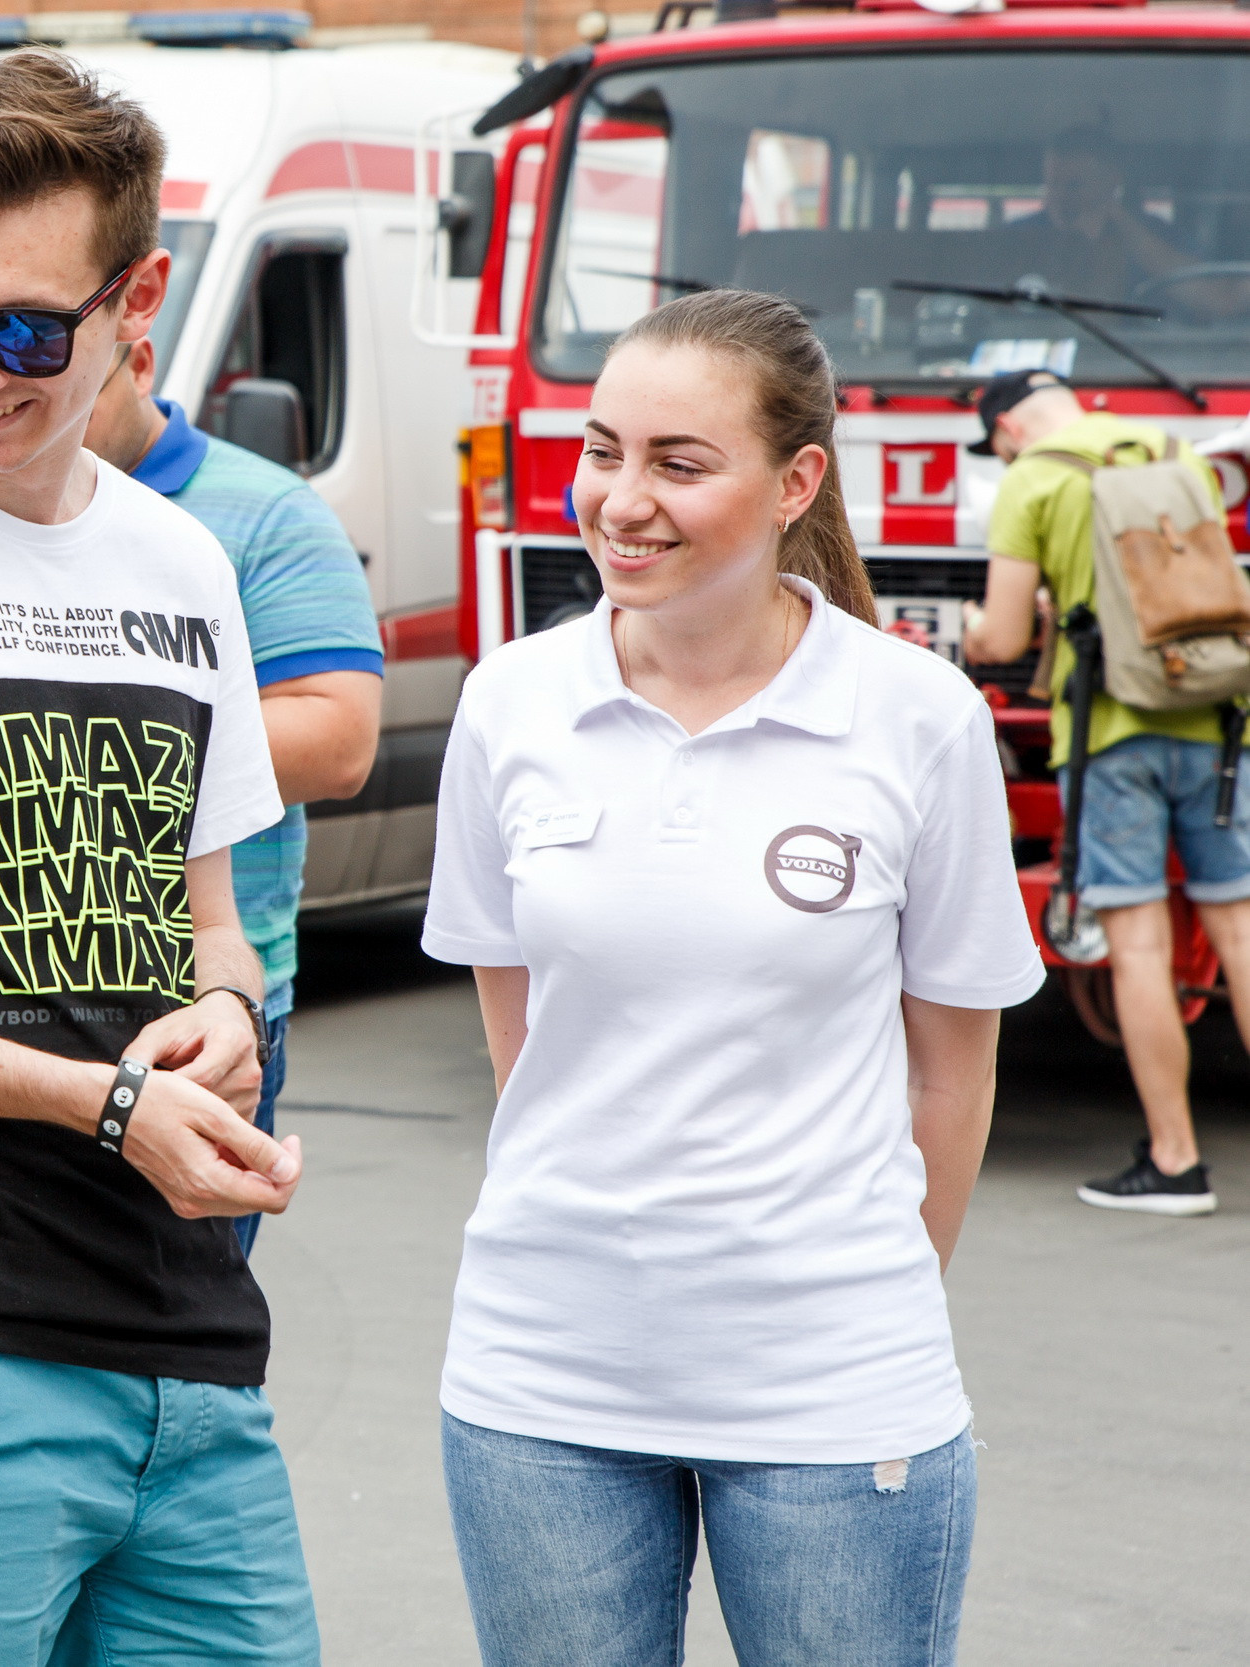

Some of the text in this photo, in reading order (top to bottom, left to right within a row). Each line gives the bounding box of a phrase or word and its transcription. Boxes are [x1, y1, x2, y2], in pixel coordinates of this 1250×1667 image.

[32, 606, 59, 620] ALL
[65, 607, 113, 621] ABOUT
[33, 623, 118, 639] CREATIVITY
[25, 638, 126, 657] CONFIDENCE.
[776, 856, 847, 880] VOLVO
[69, 1006, 126, 1024] WANTS
